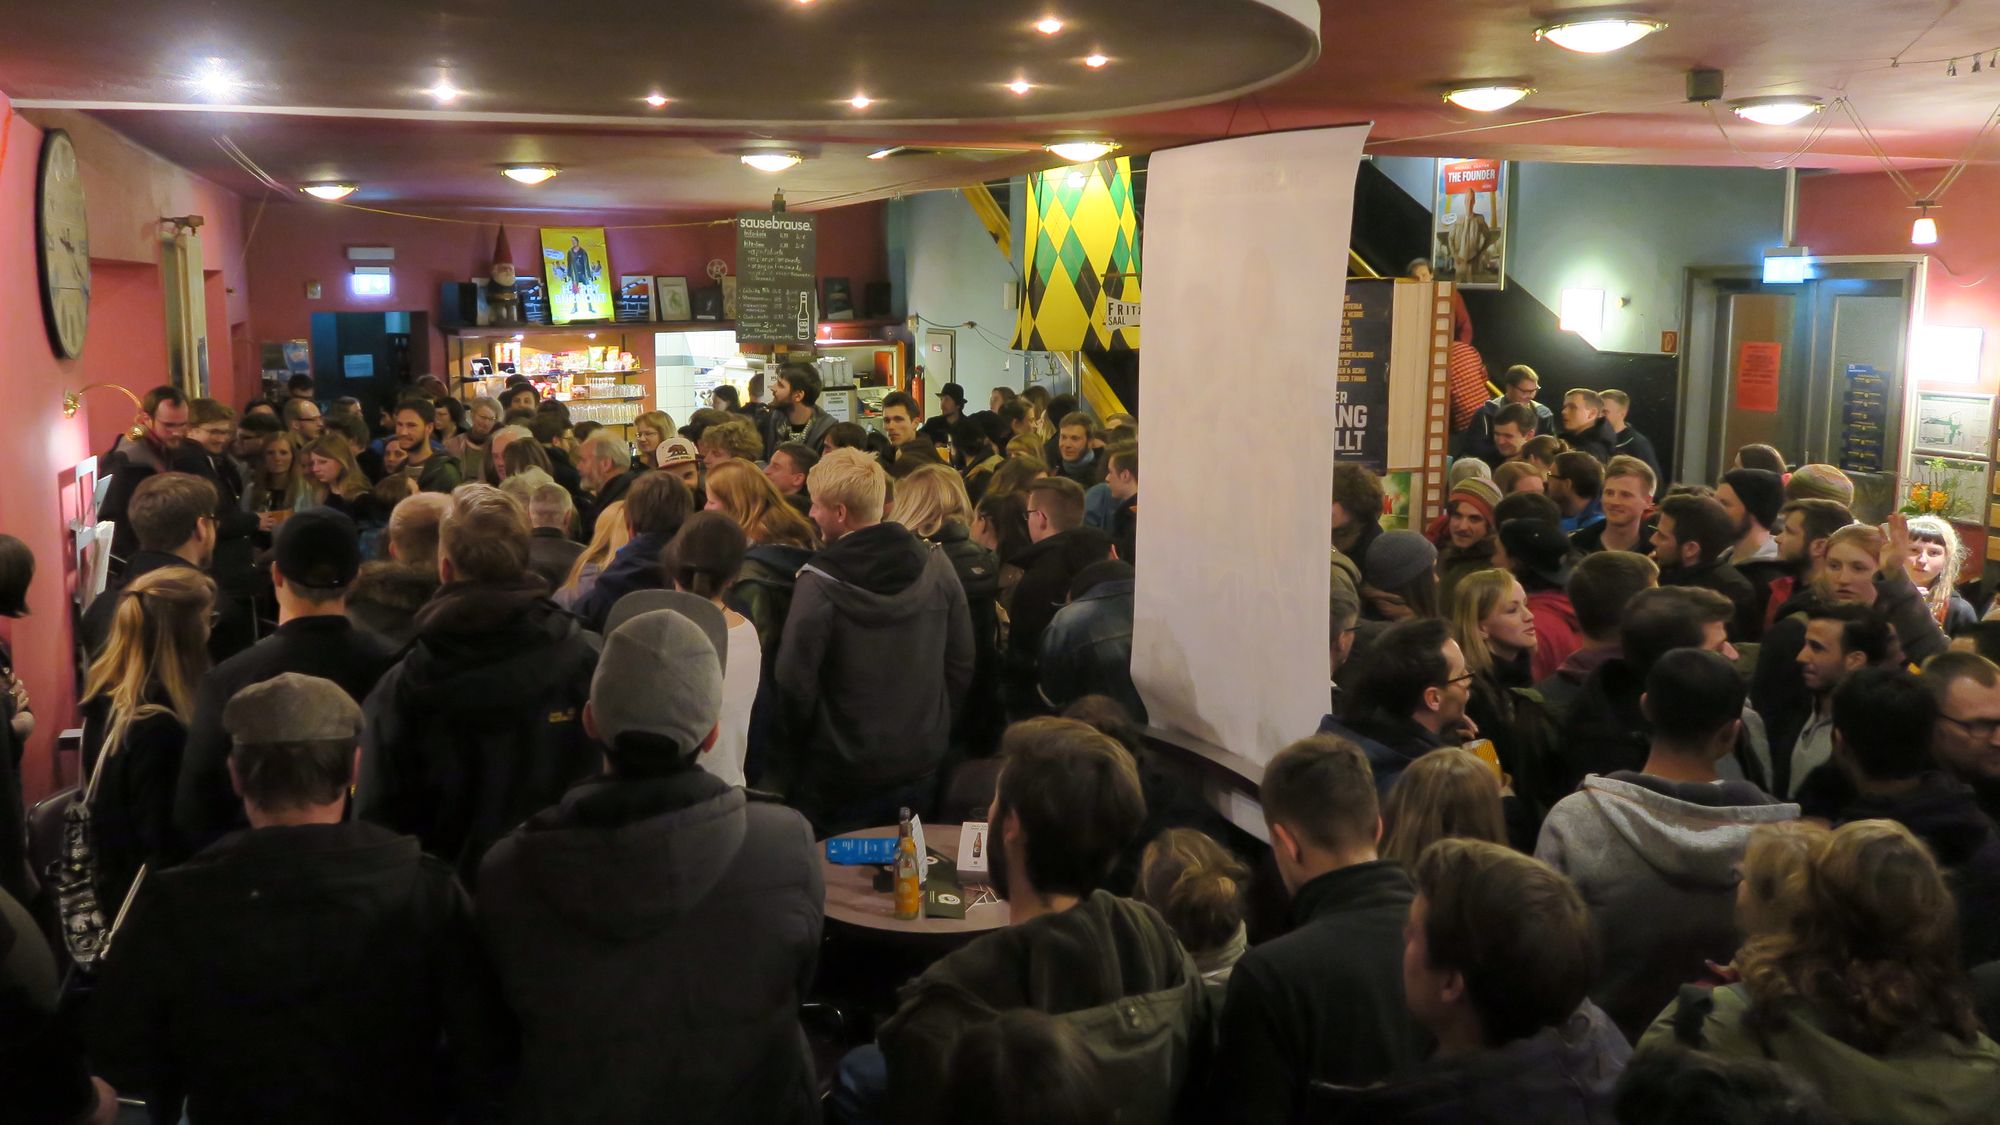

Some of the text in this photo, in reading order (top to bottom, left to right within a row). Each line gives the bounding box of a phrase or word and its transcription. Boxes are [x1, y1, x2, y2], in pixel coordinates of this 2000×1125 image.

[1448, 169, 1496, 183] THE FOUNDER
[740, 215, 812, 231] sausebrause.
[1108, 317, 1126, 325] SAAL
[1334, 430, 1366, 450] LLT
